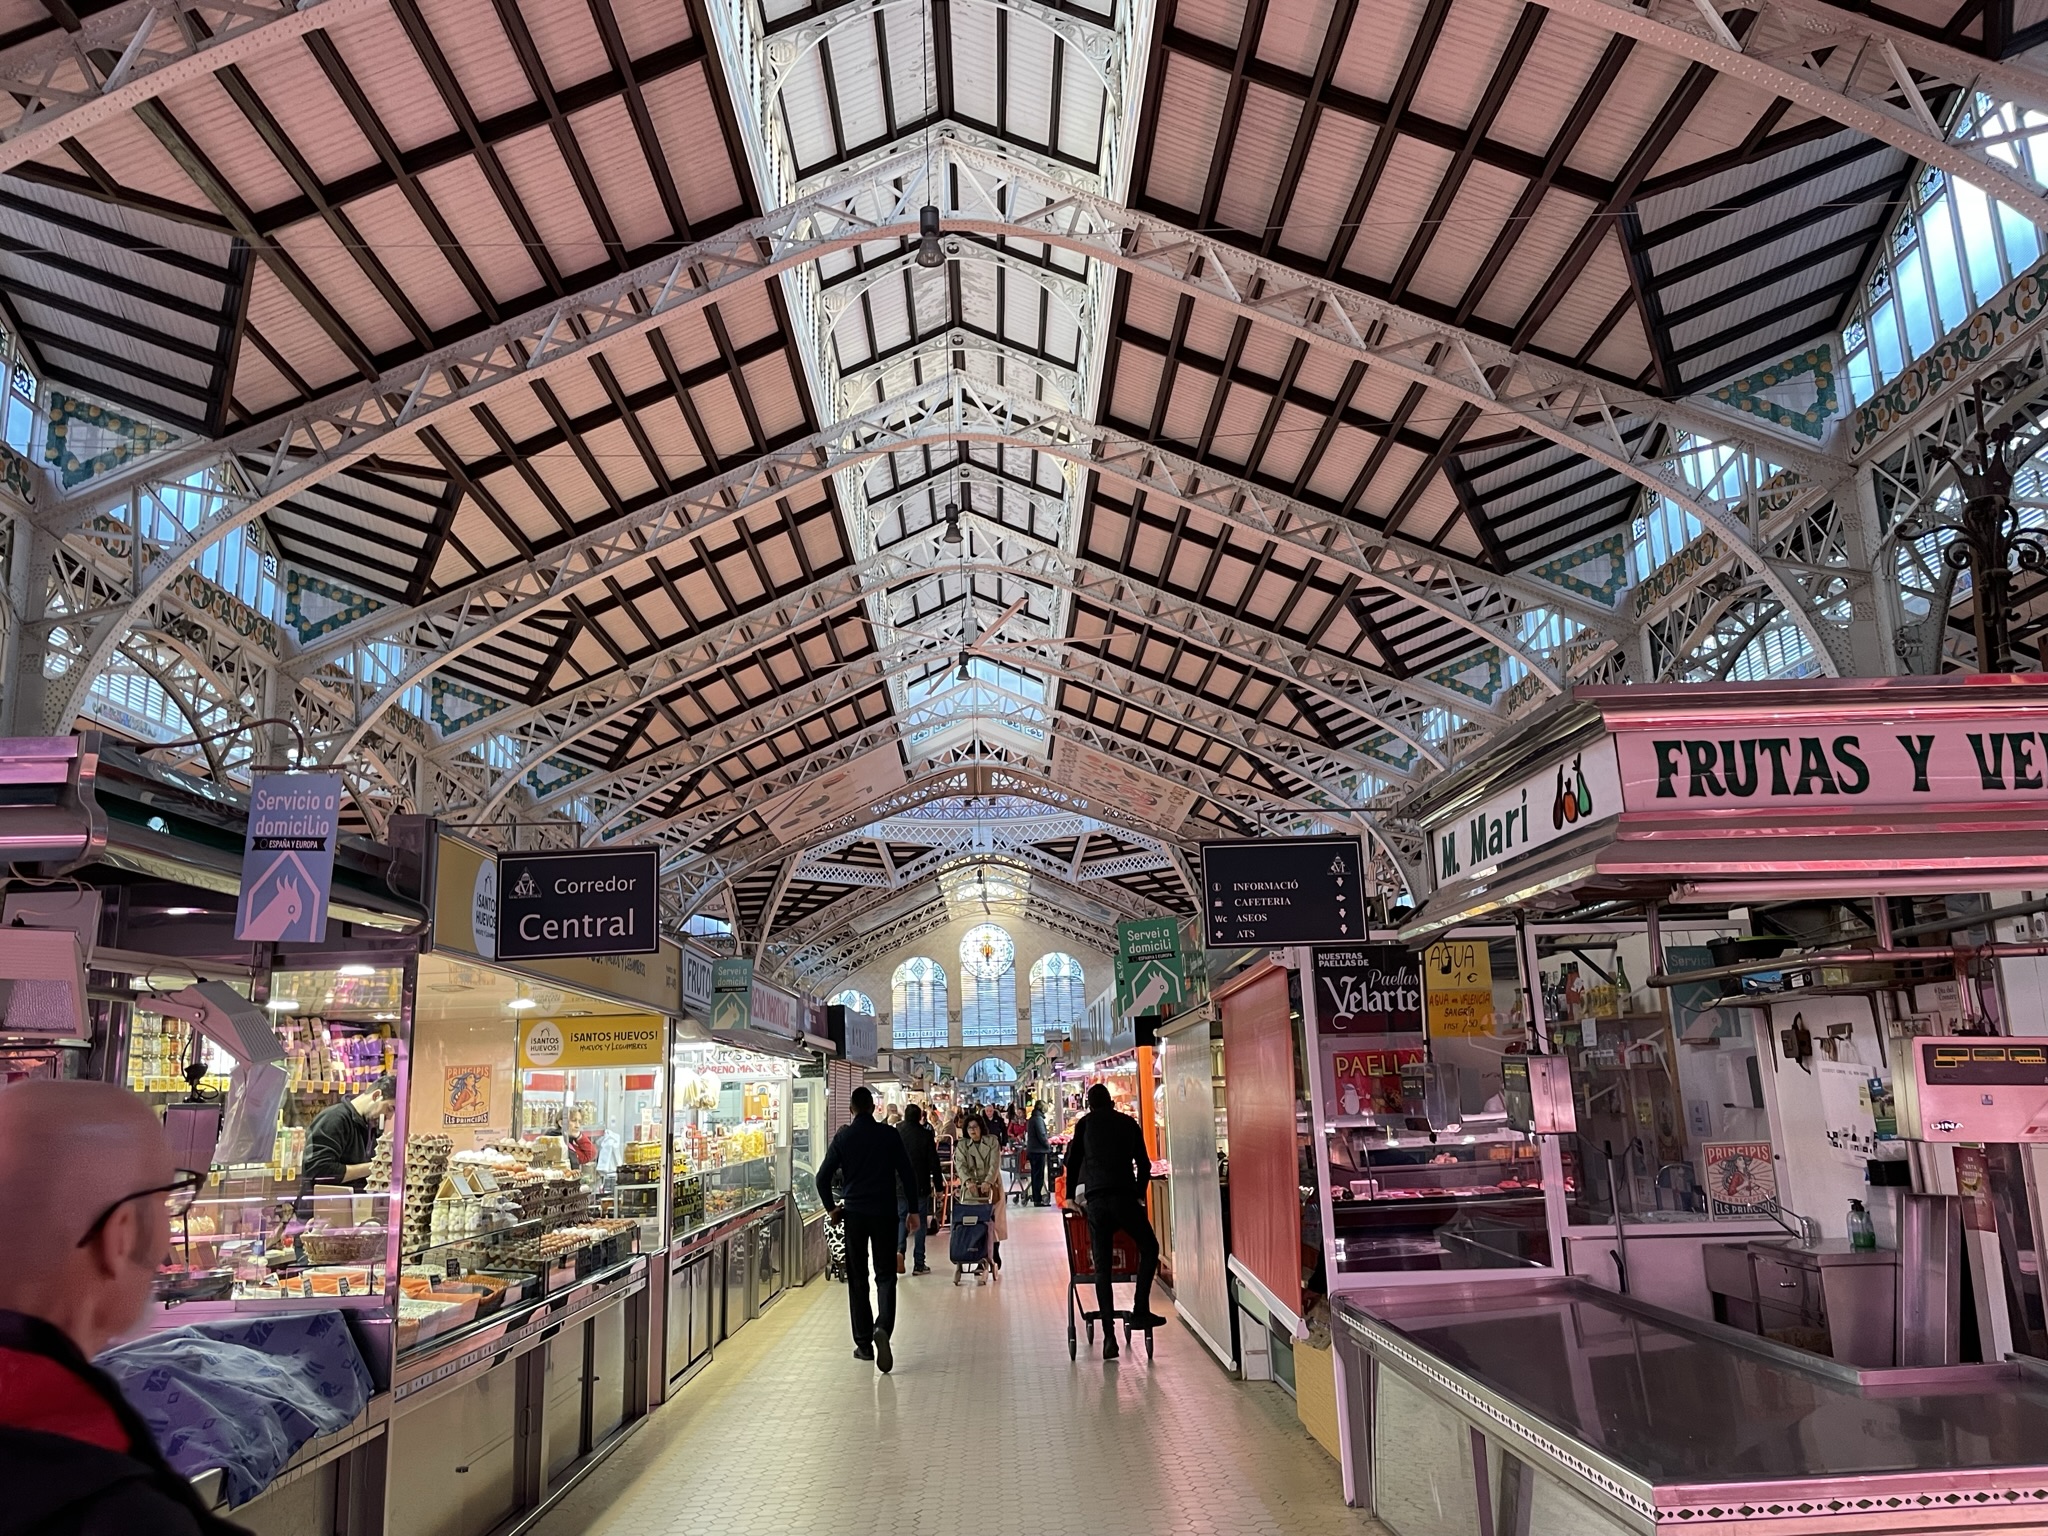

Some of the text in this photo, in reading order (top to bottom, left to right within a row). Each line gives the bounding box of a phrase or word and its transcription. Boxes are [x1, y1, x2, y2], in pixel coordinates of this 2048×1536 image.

[1652, 730, 2048, 798] FRUTAS Y VE
[256, 789, 335, 811] Servicio a
[255, 815, 330, 836] domicilio
[268, 838, 318, 849] ESPAÑA Y EUROPA
[1442, 831, 1460, 880] M.
[554, 875, 637, 895] Corredor
[1233, 879, 1299, 892] INFORMACIÓ
[1234, 897, 1291, 907] CAFETERIA
[519, 907, 635, 941] Central
[1236, 913, 1268, 923] ASEOS
[1127, 927, 1170, 942] Servei a
[1236, 929, 1256, 938] ATS
[1129, 938, 1172, 954] domicili
[1318, 952, 1363, 960] NUESTRAS
[1318, 959, 1370, 967] PAELLAS DE
[1429, 945, 1475, 970] AGUA
[718, 966, 741, 976] Servei
[1368, 966, 1419, 988] Paellas
[1454, 971, 1478, 987] 1 €
[1322, 975, 1420, 1030] Velarte
[1429, 993, 1449, 1006] AGUA
[570, 1031, 658, 1042] ¡SANTOS HUEVOS!
[611, 1042, 648, 1051] LEGUMBRES
[447, 1066, 489, 1079] PRINCIPIS
[445, 1115, 455, 1124] ELS
[1707, 1145, 1769, 1164] PRINCIPIS
[1715, 1199, 1777, 1214] ELS PRINCPIS
